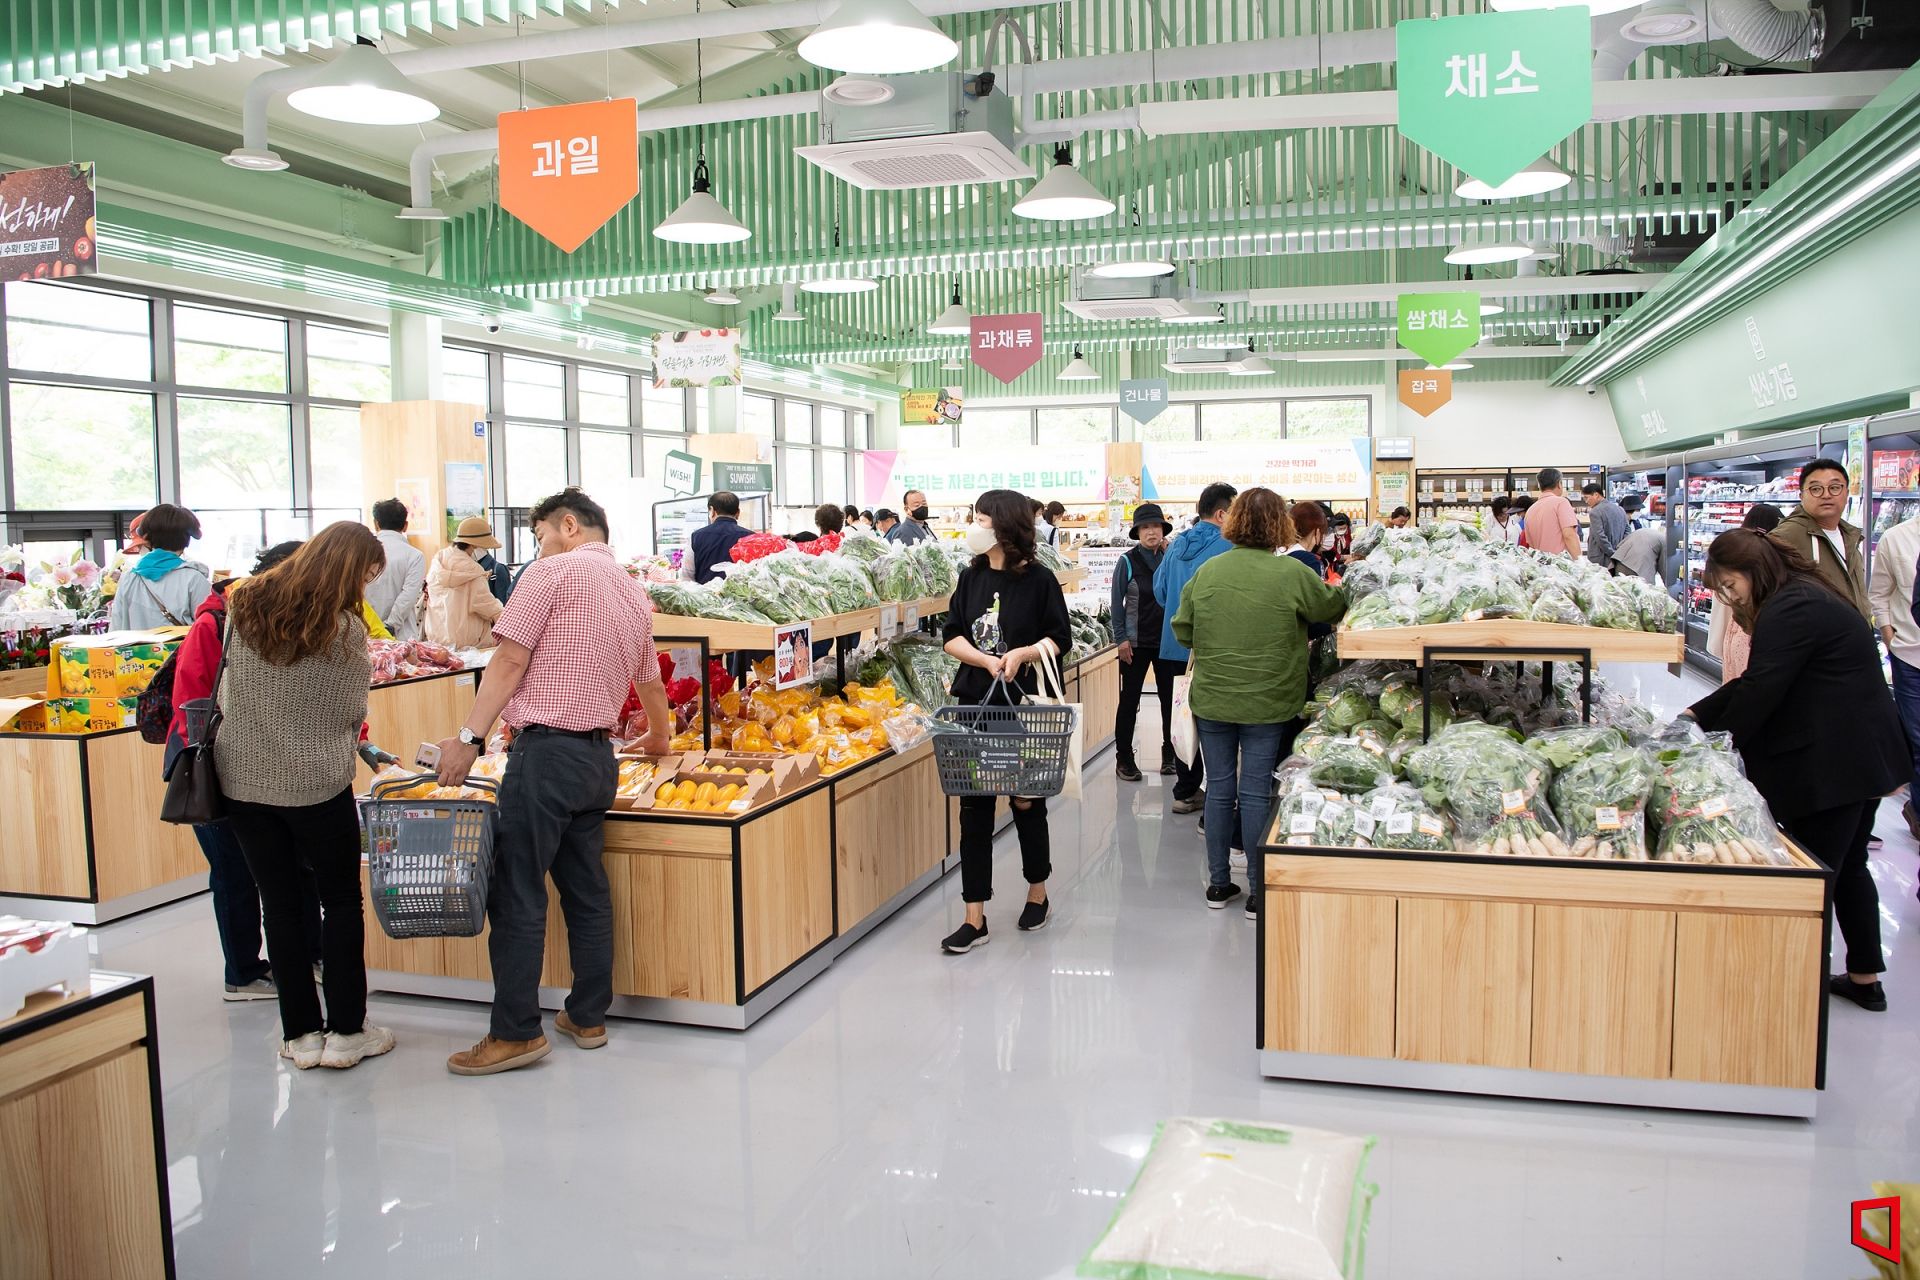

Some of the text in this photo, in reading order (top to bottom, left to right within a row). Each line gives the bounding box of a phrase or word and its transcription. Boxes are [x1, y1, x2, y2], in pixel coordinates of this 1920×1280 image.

[1445, 50, 1539, 98] 채소
[532, 135, 599, 177] 과일
[0, 195, 75, 233] 선하게!
[4, 240, 57, 255] 수확! 당일 공급!
[1407, 309, 1469, 331] 쌈채소
[978, 329, 1033, 350] 과채류
[1125, 388, 1162, 402] 건나물
[1411, 379, 1438, 394] 잡곡
[1009, 472, 1036, 488] 농민
